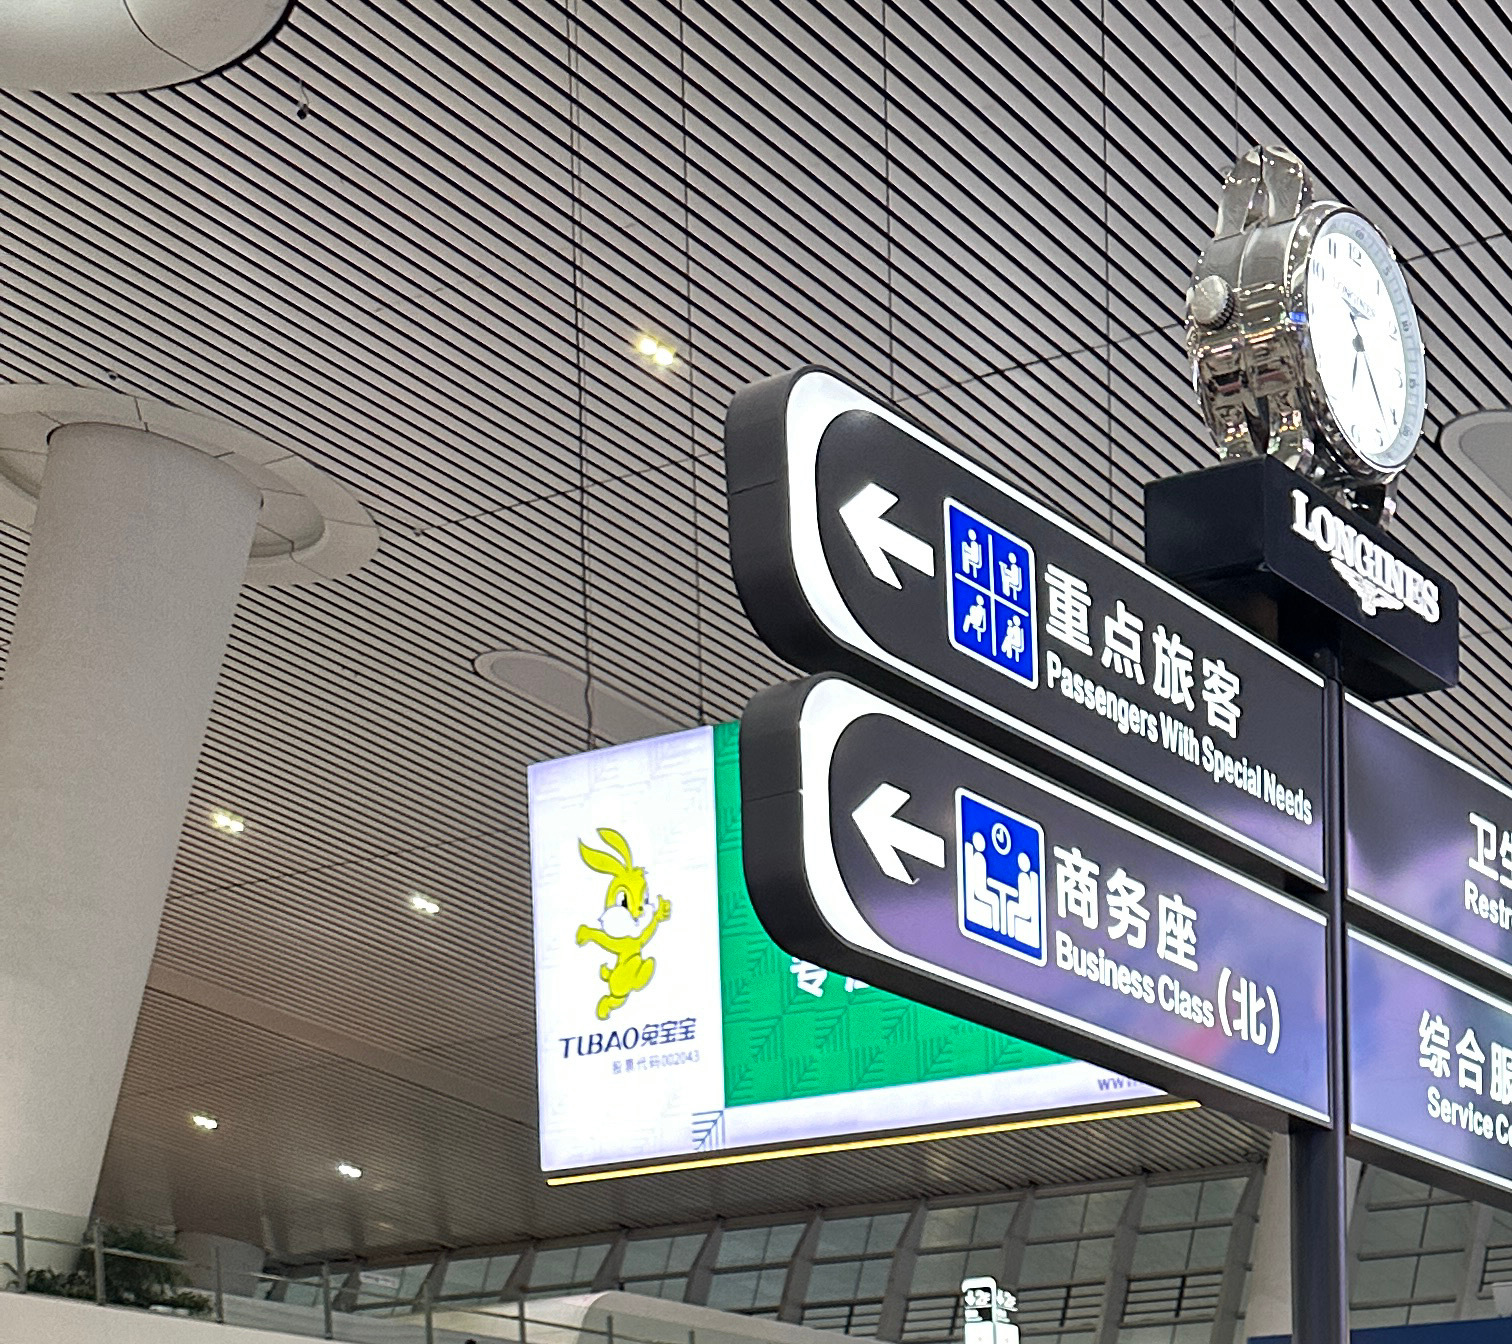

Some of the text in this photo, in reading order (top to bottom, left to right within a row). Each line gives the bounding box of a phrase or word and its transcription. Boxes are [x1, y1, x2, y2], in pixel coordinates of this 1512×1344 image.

[1291, 489, 1440, 623] LONGINES
[1044, 563, 1242, 739] 重点旅客
[1046, 650, 1313, 826] Passengers With Special Needs
[1053, 846, 1198, 972] 商务座
[1055, 930, 1215, 1028] Business Class
[1427, 1086, 1494, 1140] Service
